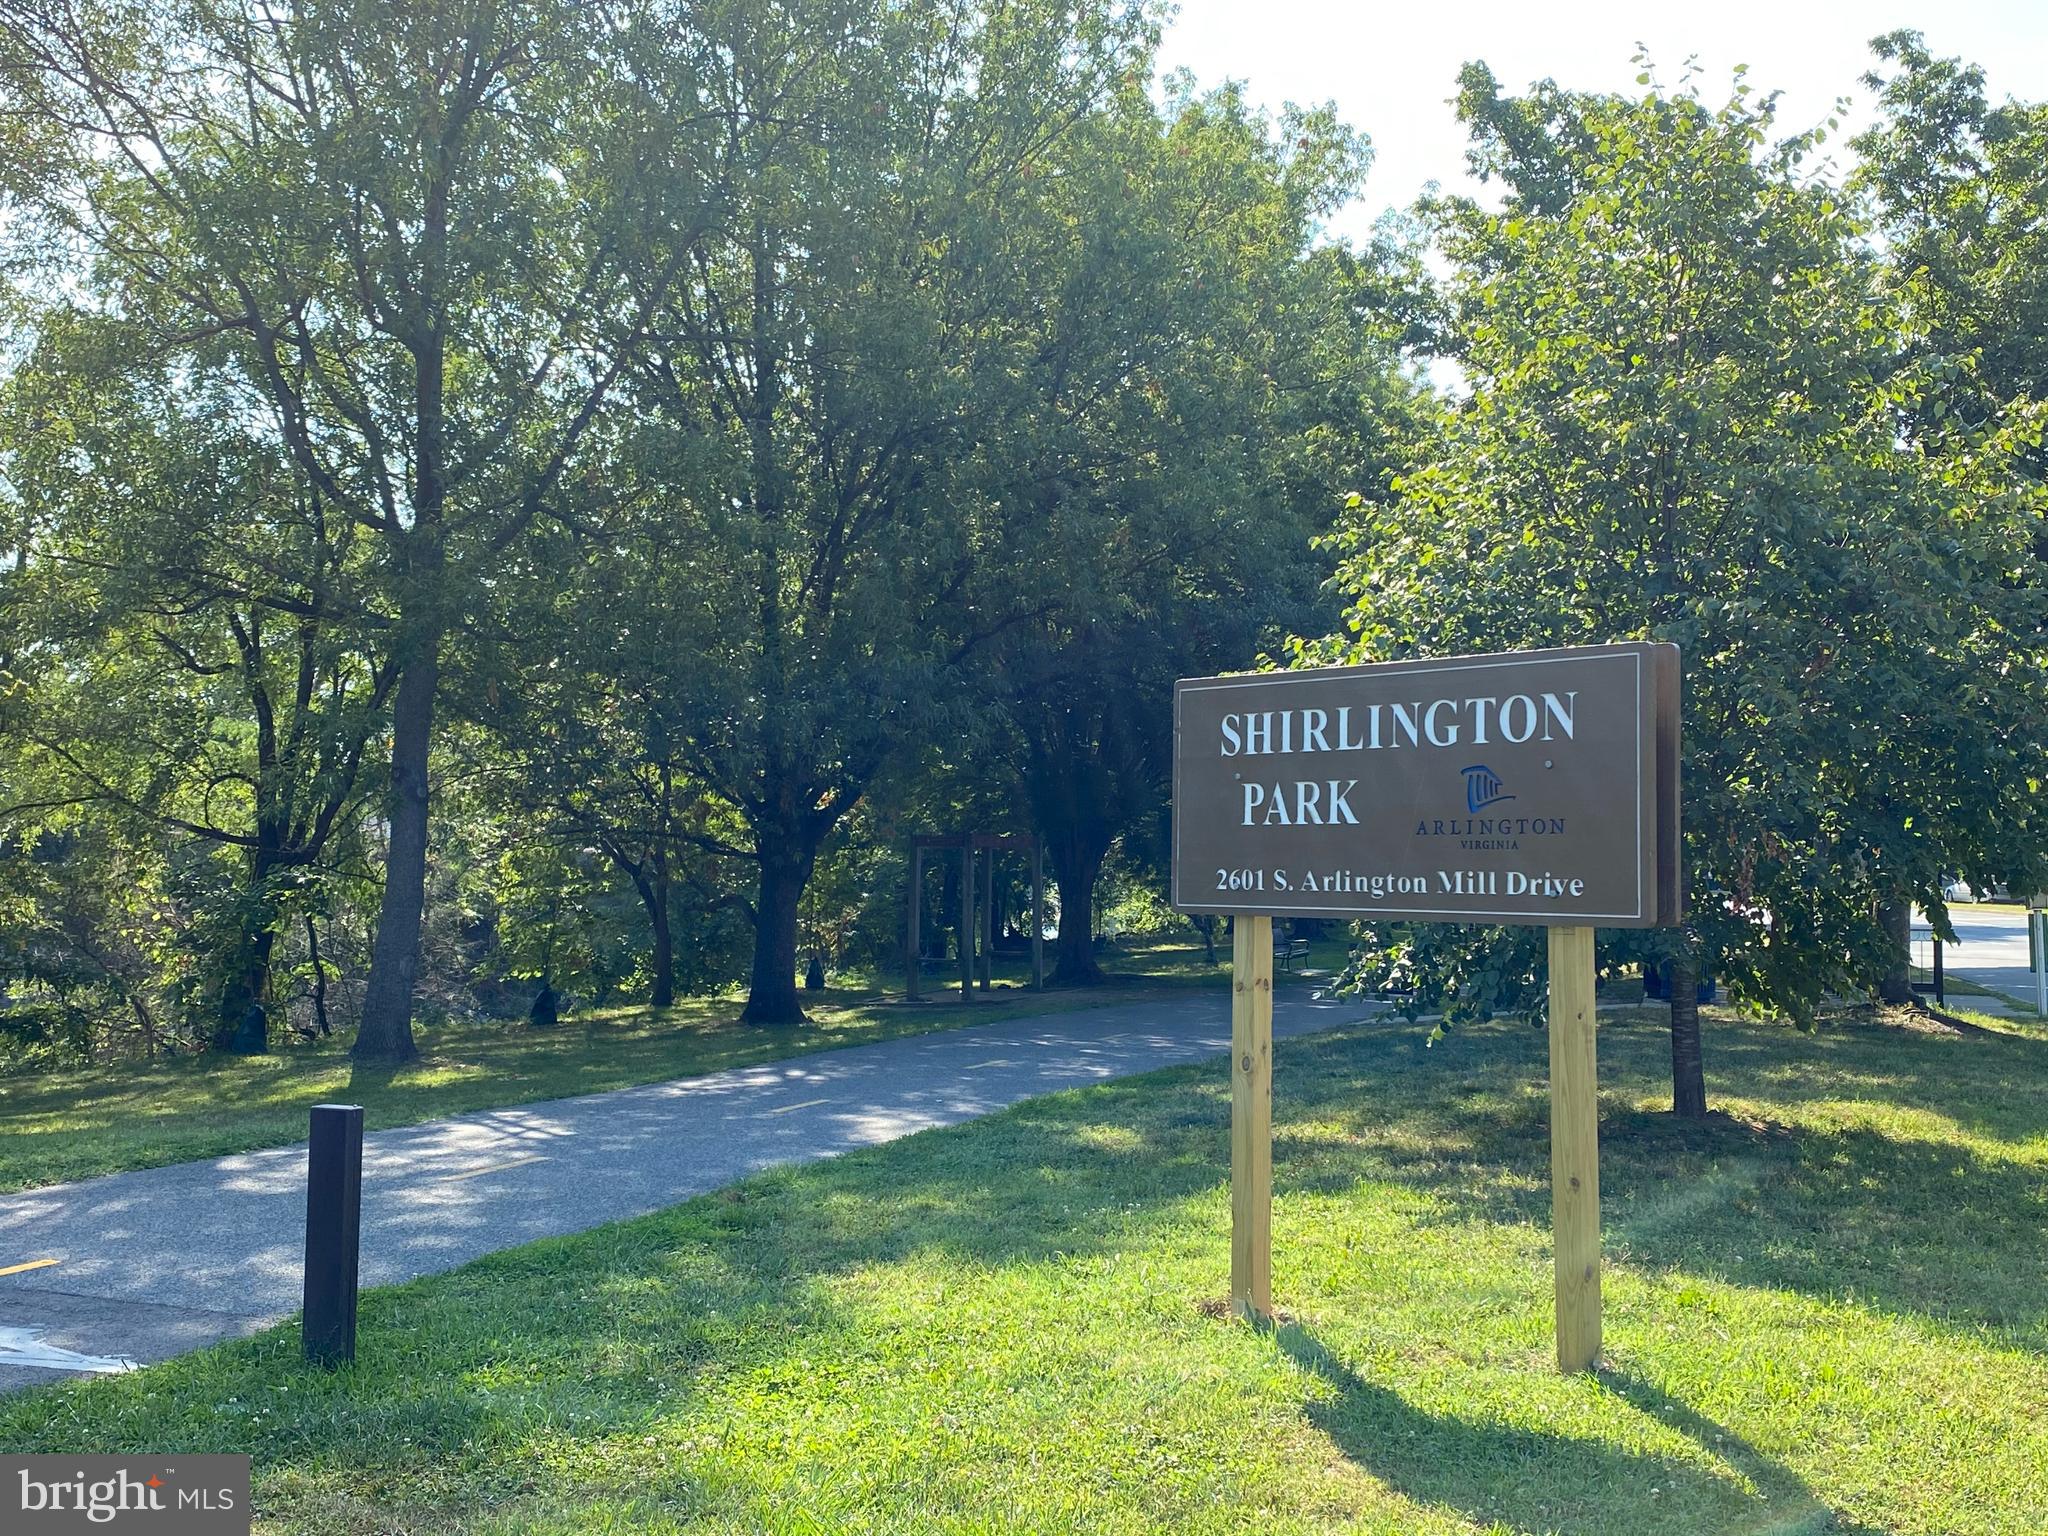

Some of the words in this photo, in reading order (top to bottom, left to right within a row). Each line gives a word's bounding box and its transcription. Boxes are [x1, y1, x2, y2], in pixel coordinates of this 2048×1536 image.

[1220, 691, 1578, 757] SHIRLINGTON
[1241, 779, 1360, 826] PARK
[1416, 818, 1566, 836] ARLINGTON
[1460, 840, 1519, 850] VIRGINIA
[1216, 868, 1265, 892] 2601
[1273, 869, 1293, 892] S.
[1301, 869, 1427, 899] Arlington
[1436, 869, 1497, 895] Mill
[1506, 870, 1584, 897] Drive
